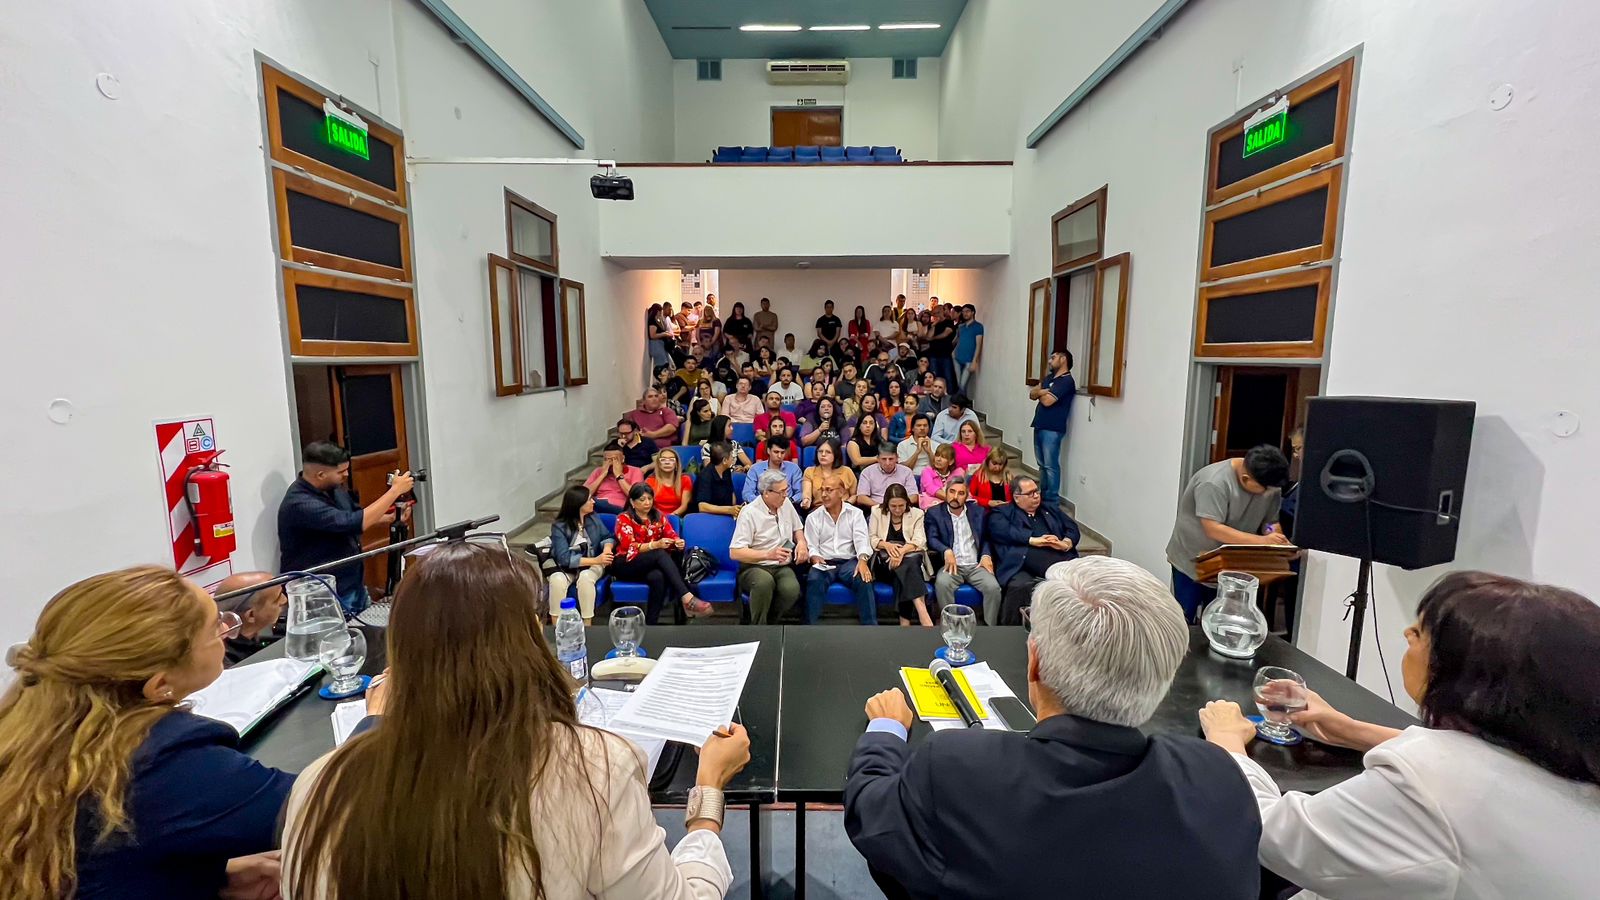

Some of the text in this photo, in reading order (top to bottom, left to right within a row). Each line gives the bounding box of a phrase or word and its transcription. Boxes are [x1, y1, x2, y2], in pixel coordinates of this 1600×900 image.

[331, 122, 367, 154] SALIDA
[1246, 120, 1280, 151] SALIDA
[188, 438, 211, 451] B C
